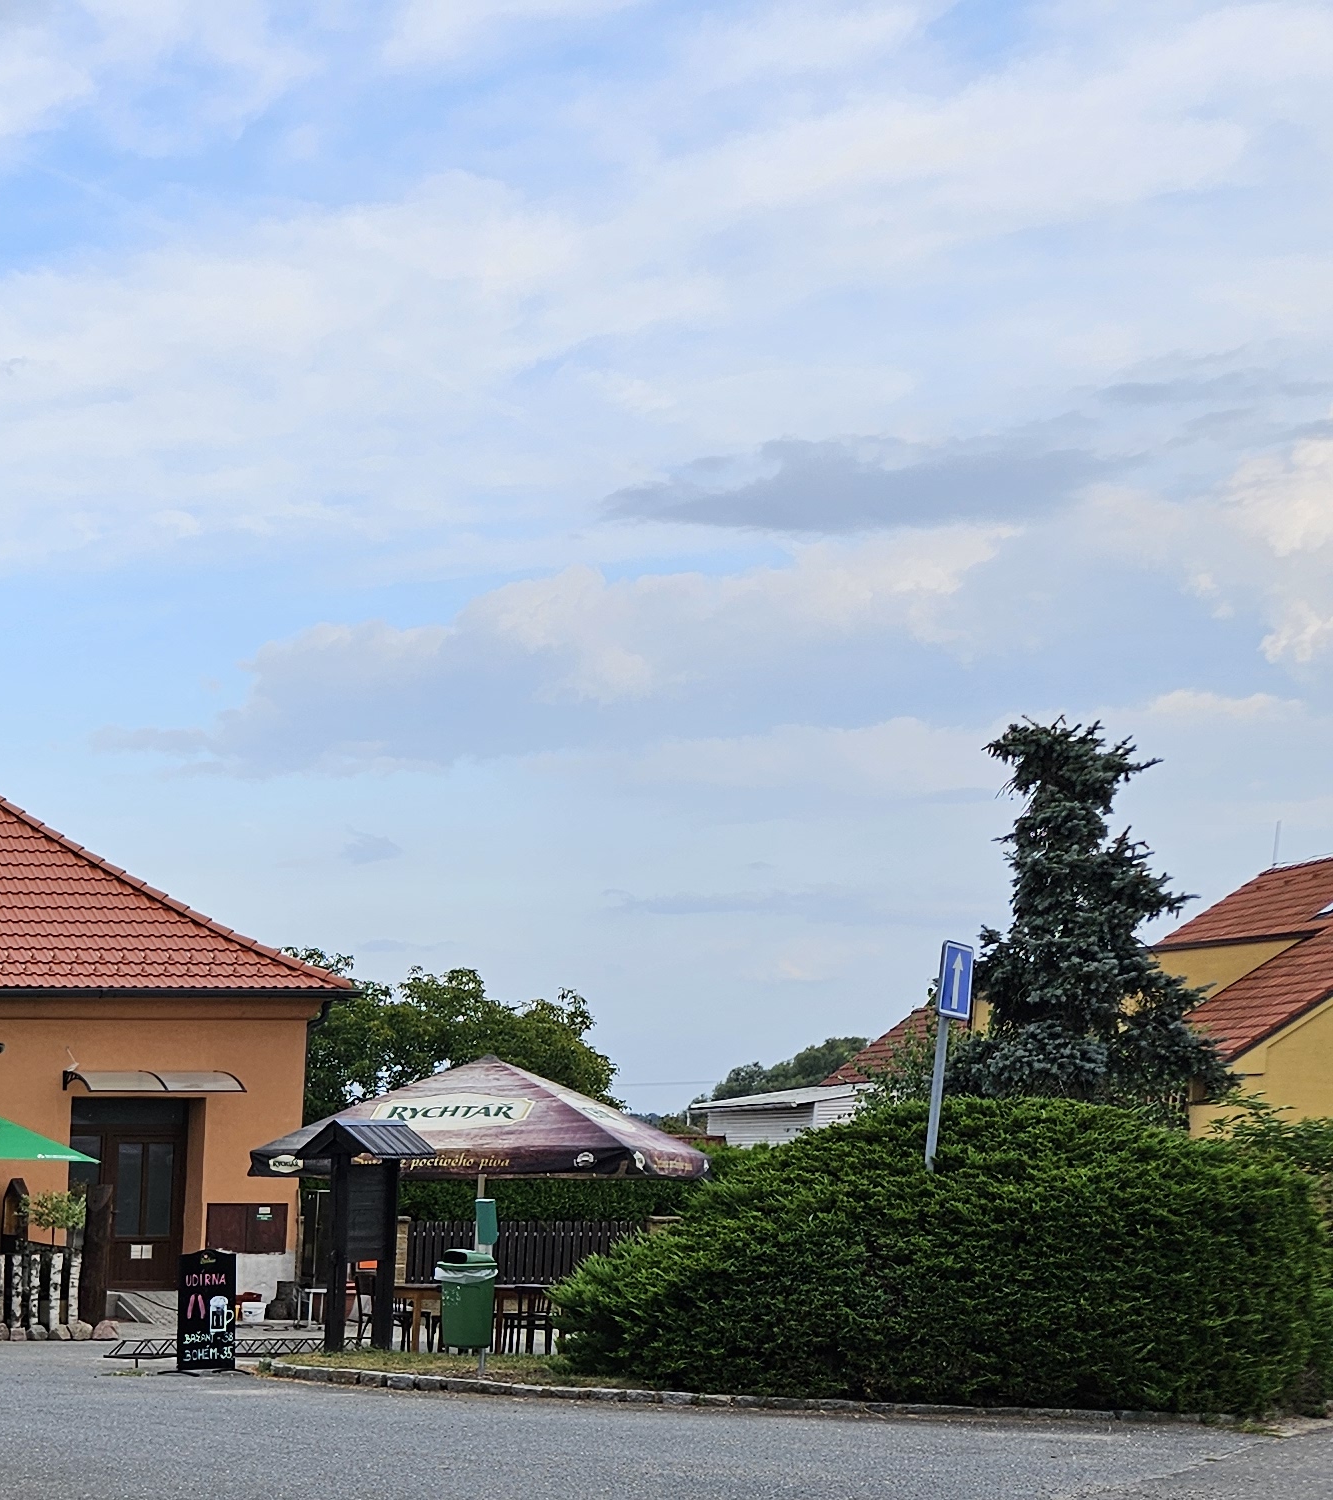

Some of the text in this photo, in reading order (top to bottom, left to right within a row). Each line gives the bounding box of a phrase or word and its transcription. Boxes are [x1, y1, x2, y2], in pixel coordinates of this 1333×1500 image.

[387, 1102, 516, 1121] RYCHTÁŘ
[479, 1155, 510, 1170] piva
[185, 1269, 226, 1287] UDÍRNA
